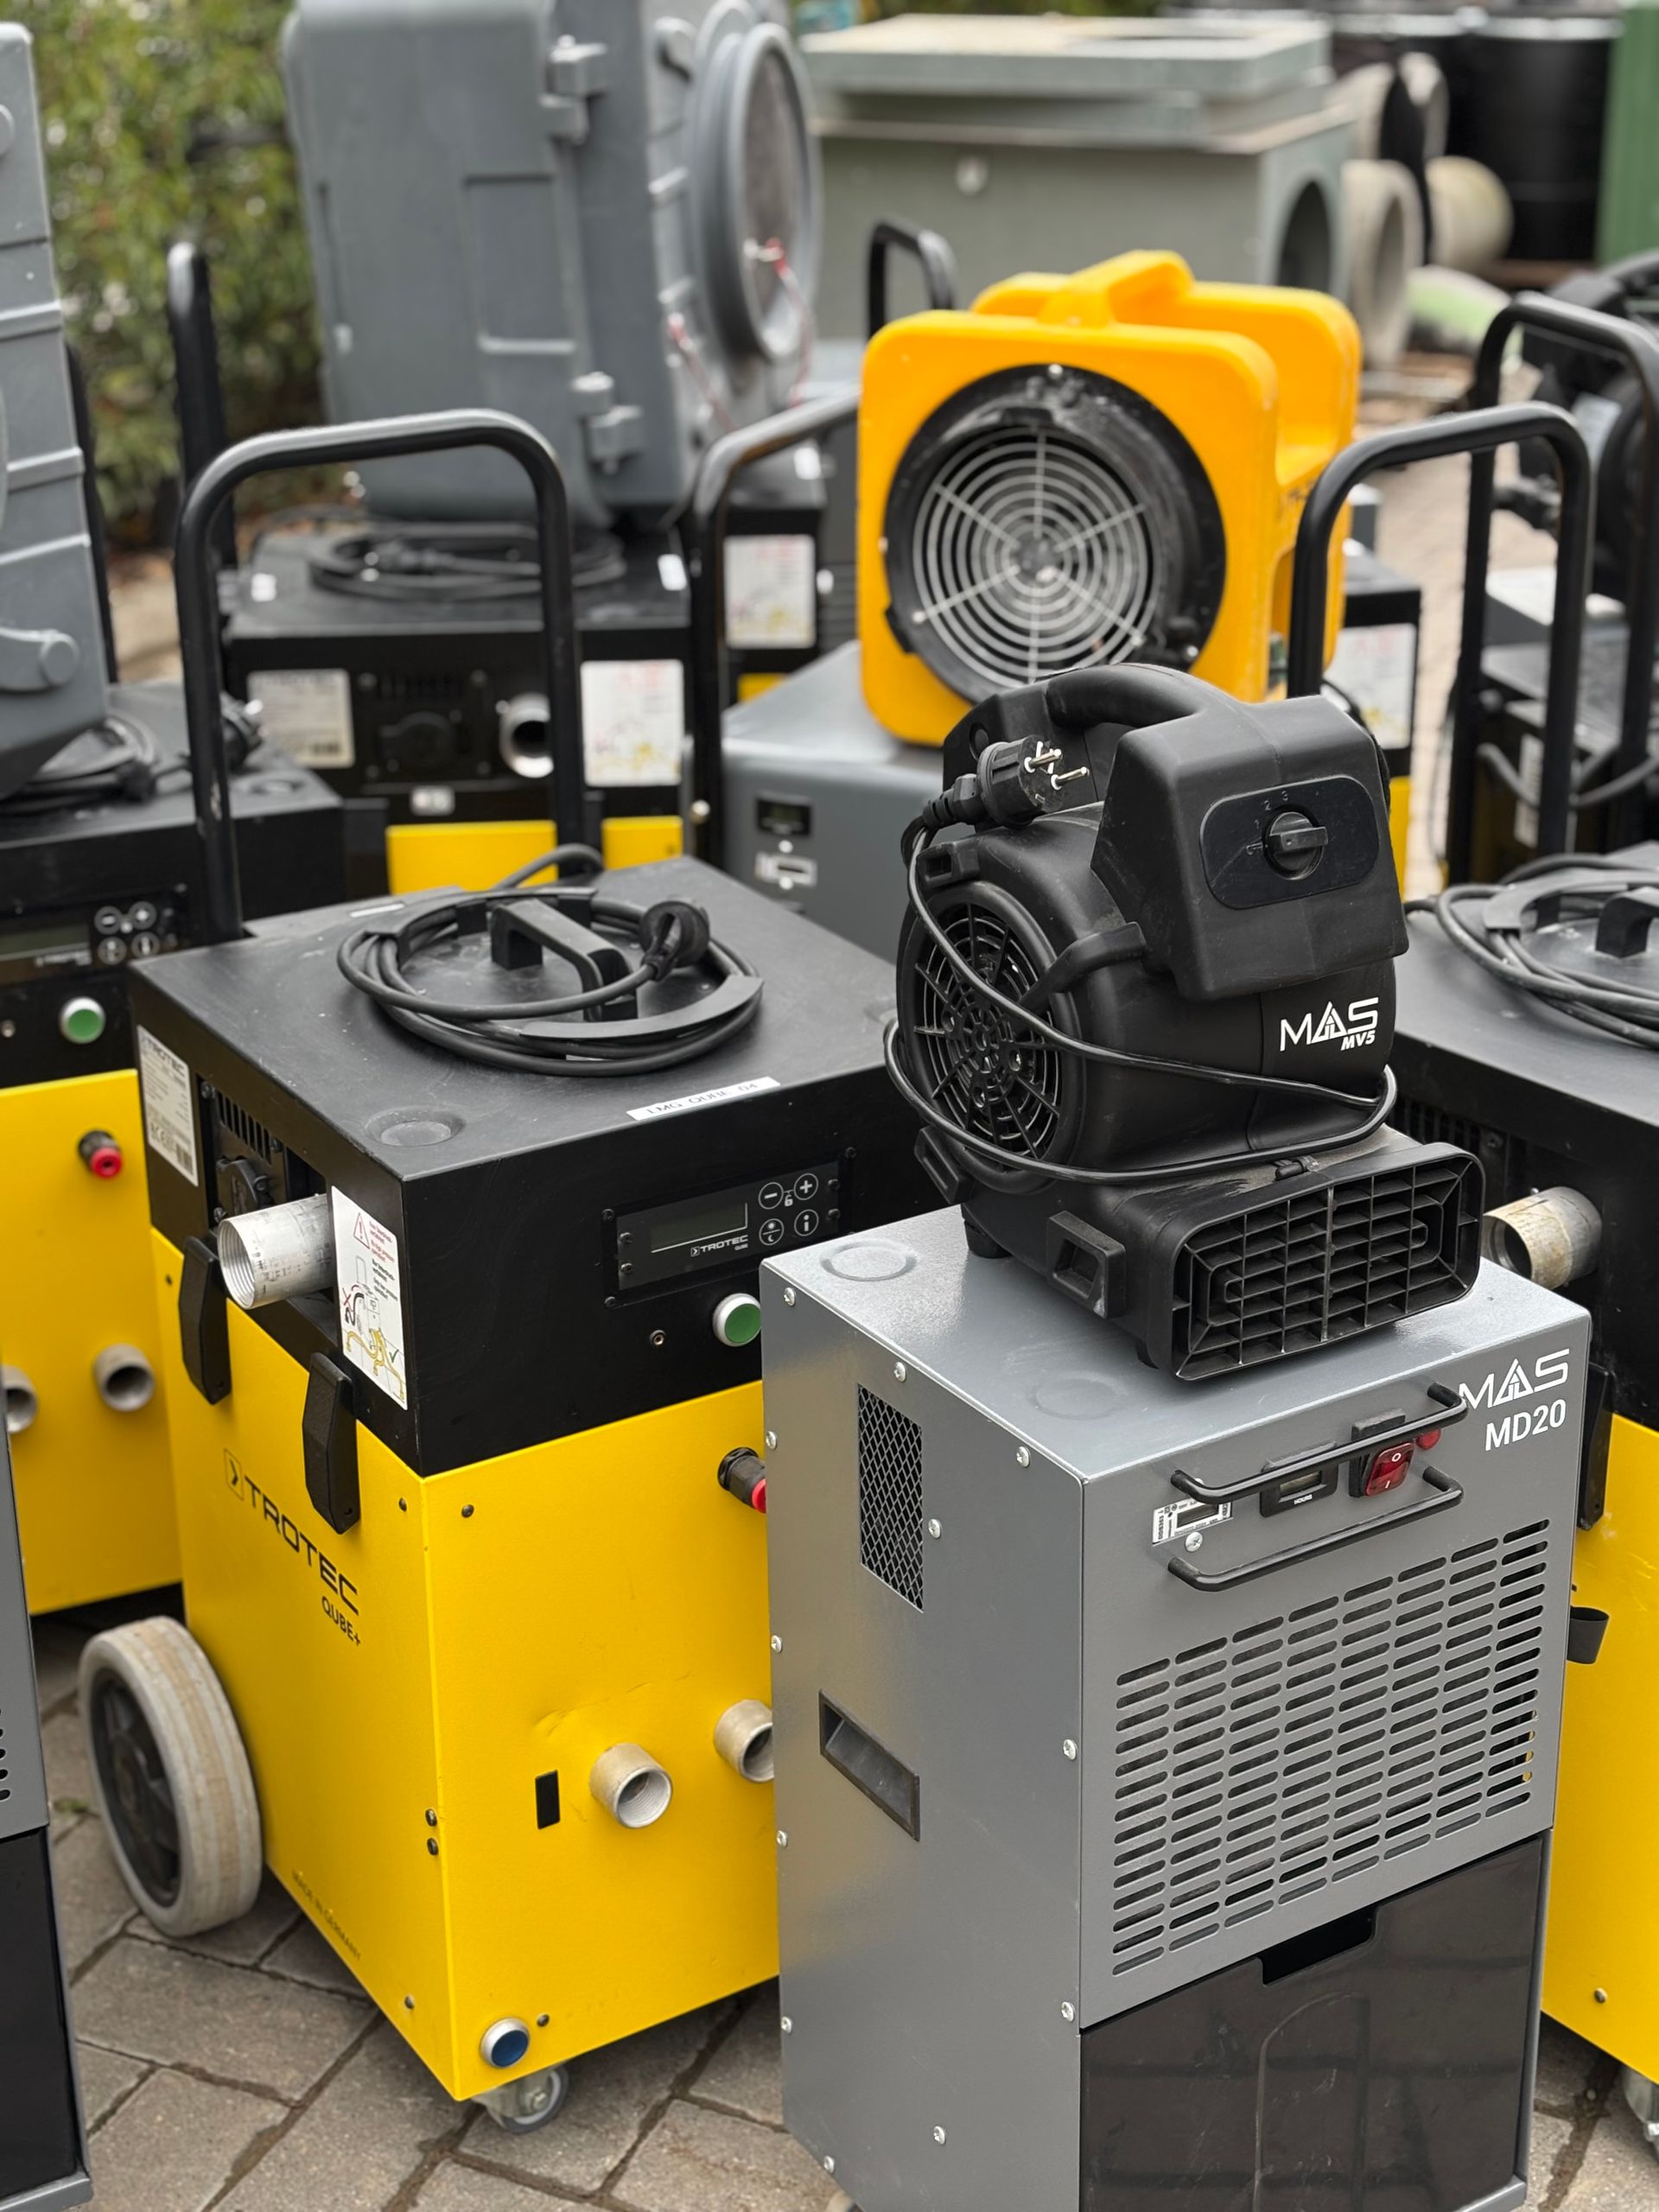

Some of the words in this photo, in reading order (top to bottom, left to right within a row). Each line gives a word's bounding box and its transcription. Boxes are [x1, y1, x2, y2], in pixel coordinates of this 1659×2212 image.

[1263, 799, 1272, 811] 2
[1280, 996, 1379, 1052] MAS
[1340, 1029, 1376, 1052] MV5
[645, 1101, 683, 1115] LMG
[701, 1234, 749, 1253] TROTEC
[1459, 1348, 1570, 1410] MAS
[1484, 1398, 1567, 1452] MD20
[244, 1474, 359, 1617] TROTEC
[321, 1595, 361, 1646] QUBE+
